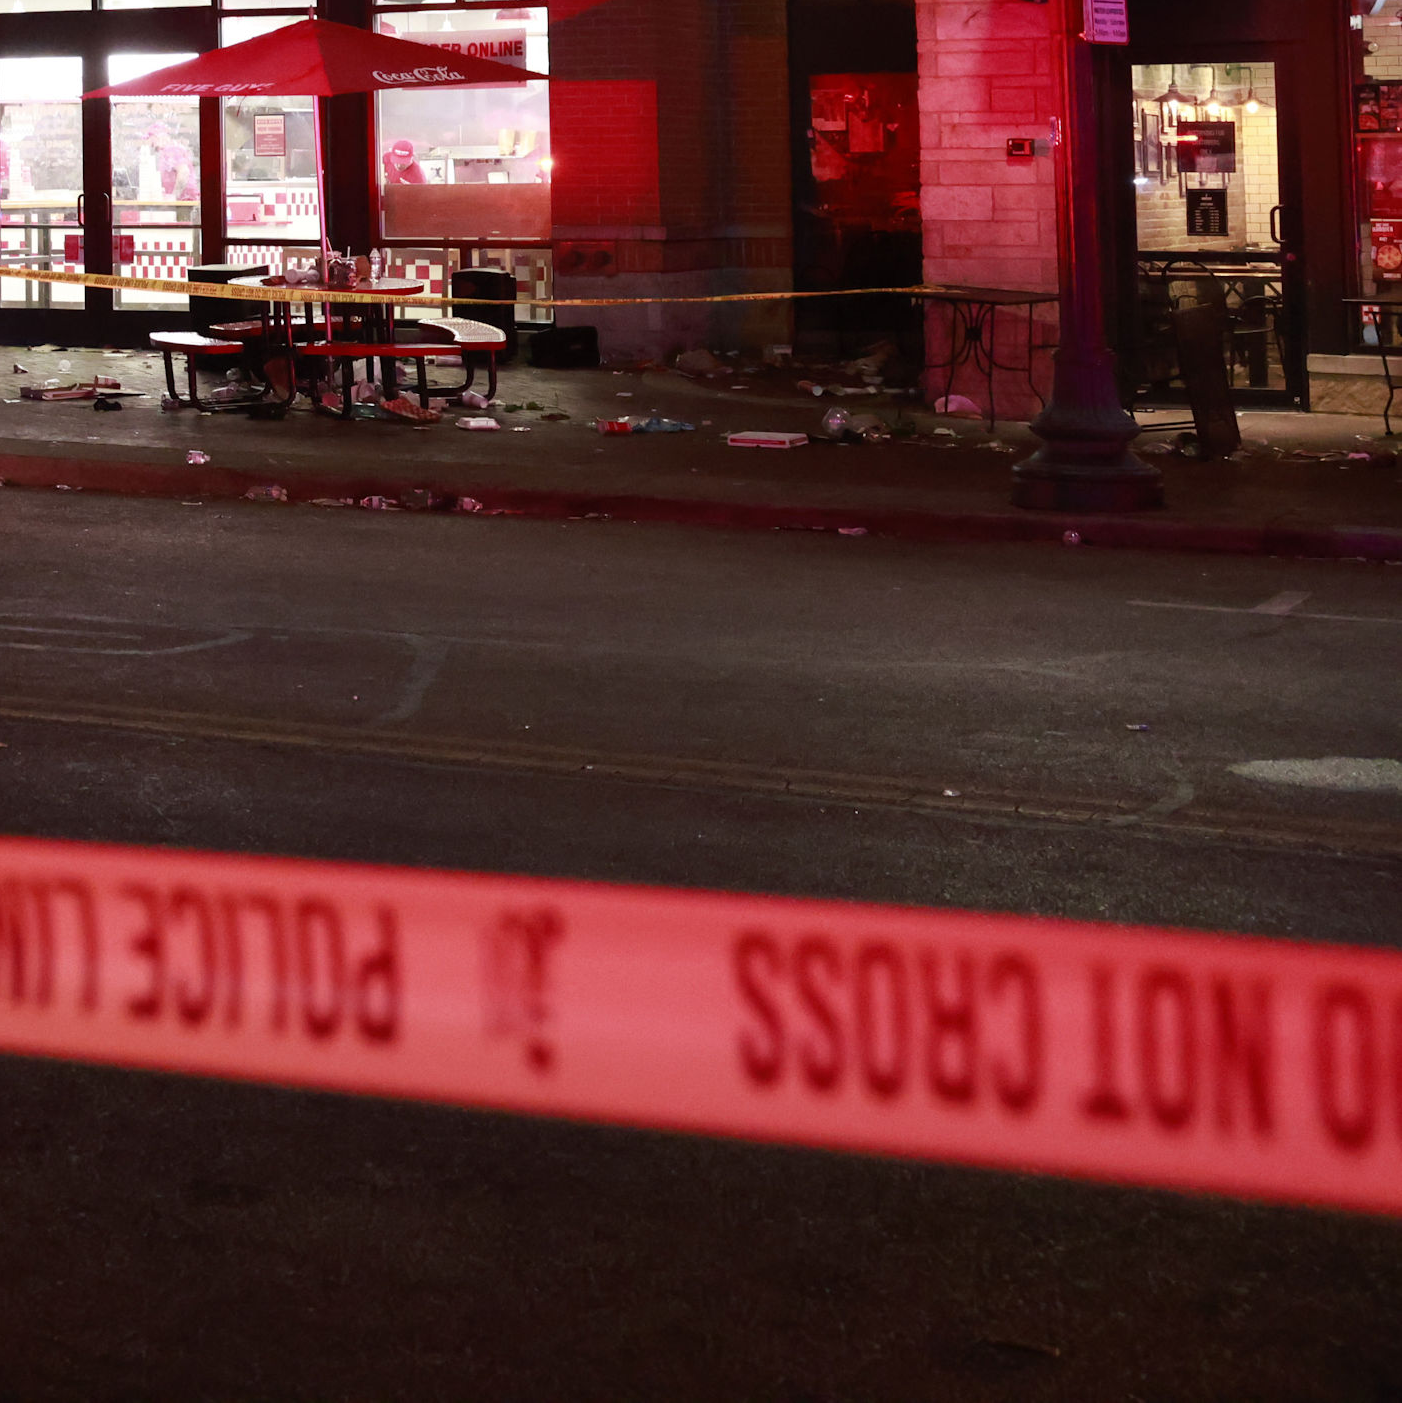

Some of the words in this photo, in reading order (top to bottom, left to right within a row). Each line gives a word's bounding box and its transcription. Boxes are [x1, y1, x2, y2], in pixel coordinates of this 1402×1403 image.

[160, 83, 214, 92] FIVE
[468, 40, 523, 57] ONLINE
[121, 883, 399, 1044] POLICE
[730, 928, 1043, 1116] CROSS
[1077, 958, 1277, 1141] NOT
[1312, 980, 1402, 1155] O
